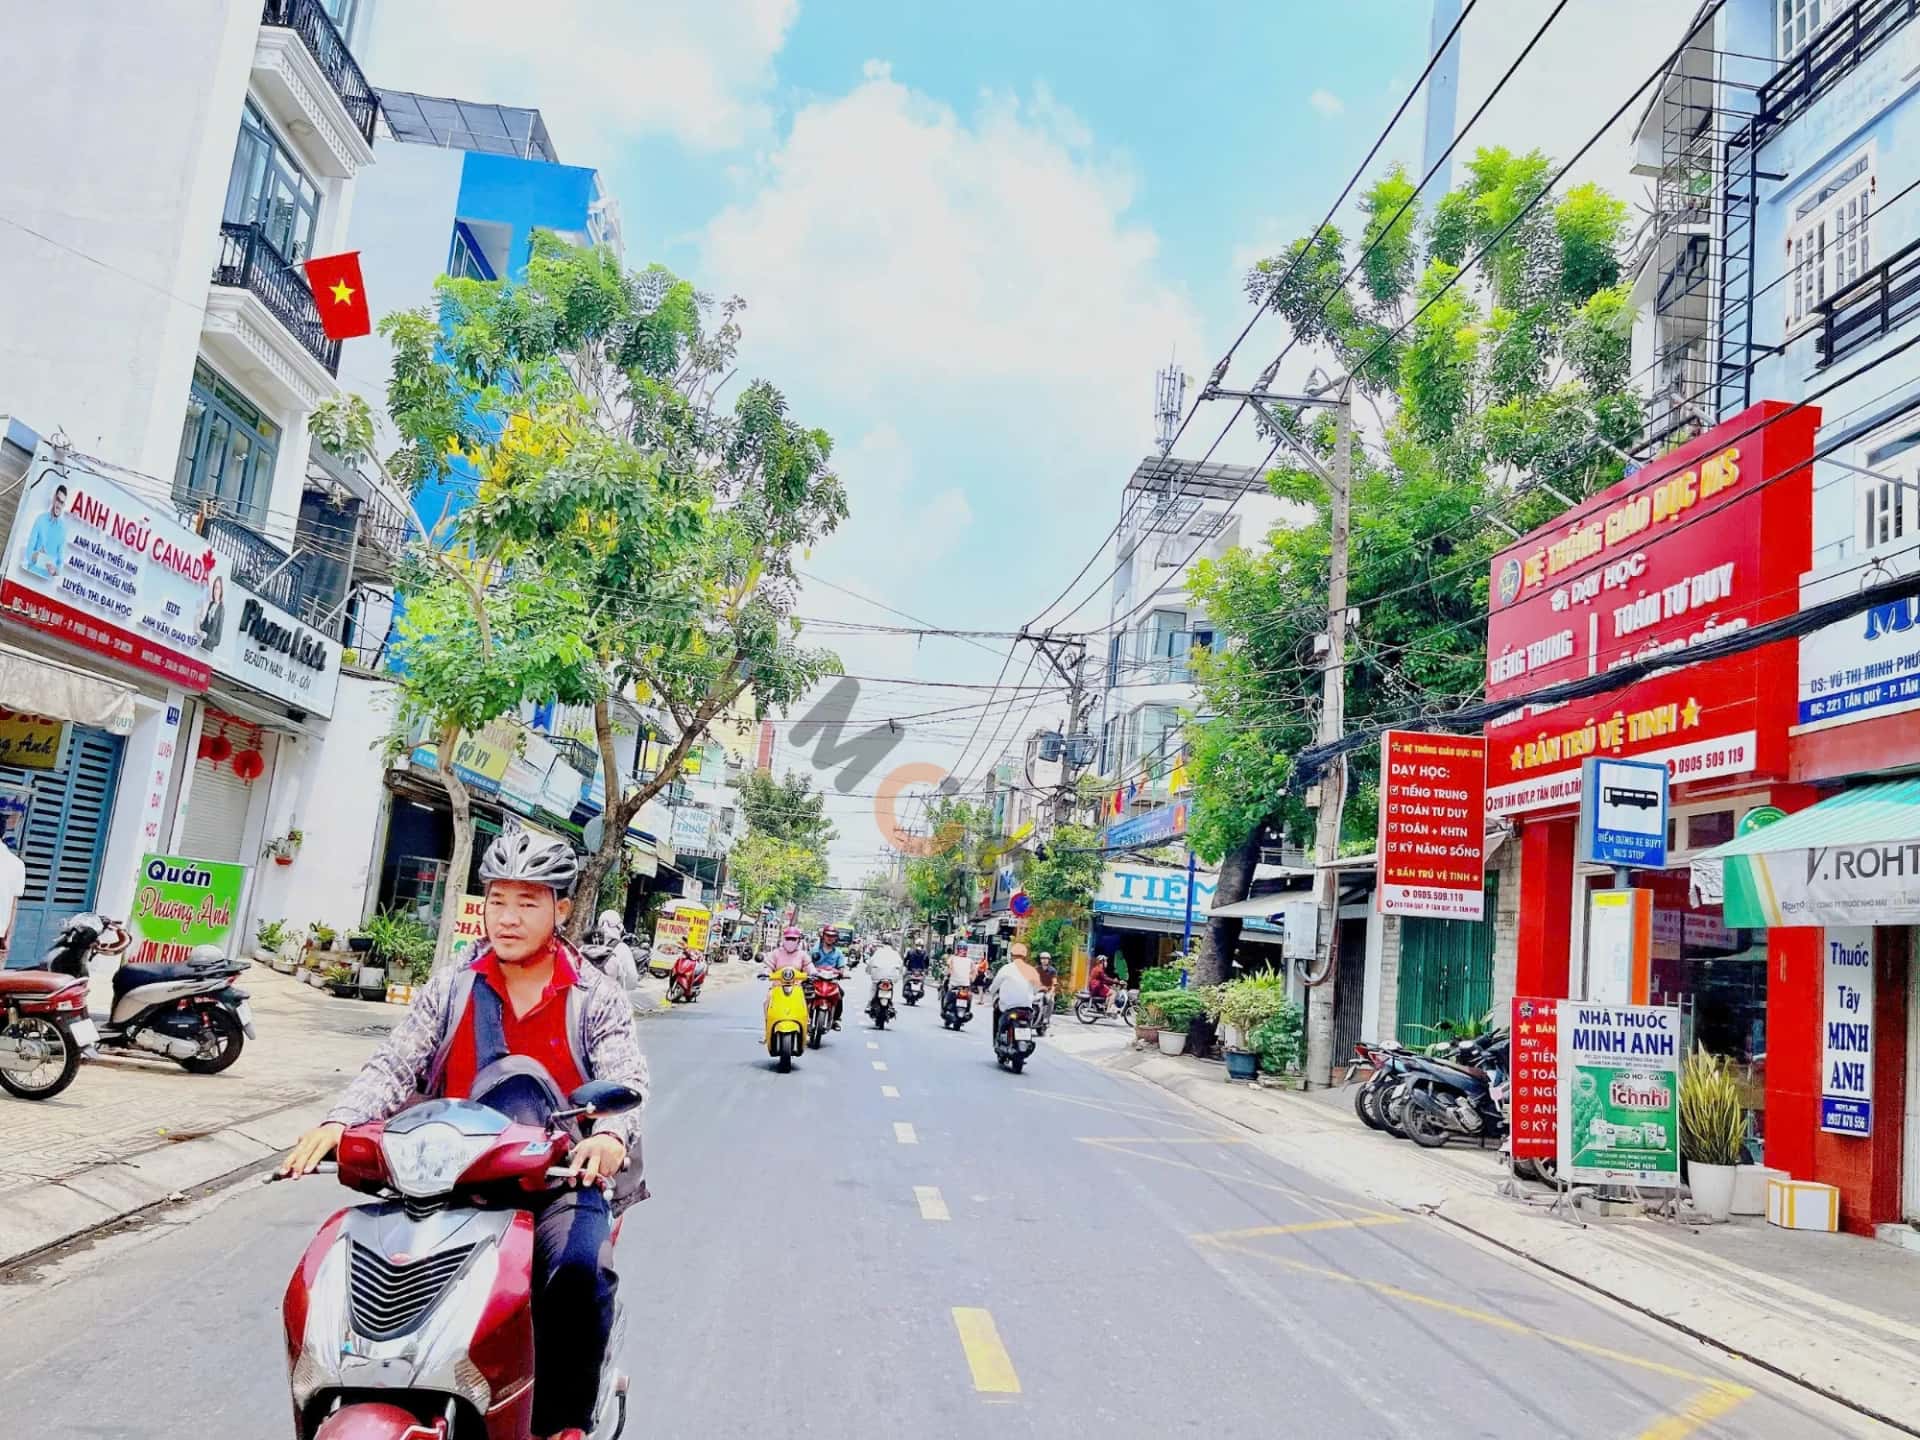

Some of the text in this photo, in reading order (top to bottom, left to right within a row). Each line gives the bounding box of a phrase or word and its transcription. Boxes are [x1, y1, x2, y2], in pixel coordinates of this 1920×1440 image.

[70, 490, 210, 583] ANH NGỮ CANADA
[1613, 589, 1661, 638] TOÁN
[1690, 561, 1735, 608] DUY
[243, 648, 270, 673] BEAUTY
[268, 662, 283, 679] NAIL
[1865, 659, 1893, 681] MINH
[1844, 693, 1861, 709] TÂN
[1523, 703, 1678, 768] BÁN TRÚ VỆ TINH
[1391, 763, 1450, 780] DẠY HỌC:
[1678, 745, 1744, 774] 0905 509 119
[1401, 784, 1468, 801] TIẾNG TRUNG
[1401, 803, 1468, 818] TOÁN TƯ DUY
[1400, 822, 1429, 835] TOÁN
[1441, 825, 1468, 838] KHTN
[1399, 841, 1480, 858] KỸ NĂNG SỐNG
[146, 858, 213, 888] Quán
[1397, 866, 1416, 878] BÁN
[1450, 871, 1470, 881] TINH
[138, 886, 231, 934] Phương Anh
[1830, 942, 1869, 968] Thuốc
[1838, 985, 1860, 1014] Tây
[1579, 1008, 1611, 1026] NHÀ
[1615, 1010, 1668, 1030] THUỐC
[1573, 1028, 1674, 1056] MINH ANH
[1827, 1022, 1869, 1053] MINH
[1830, 1060, 1865, 1092] ANH
